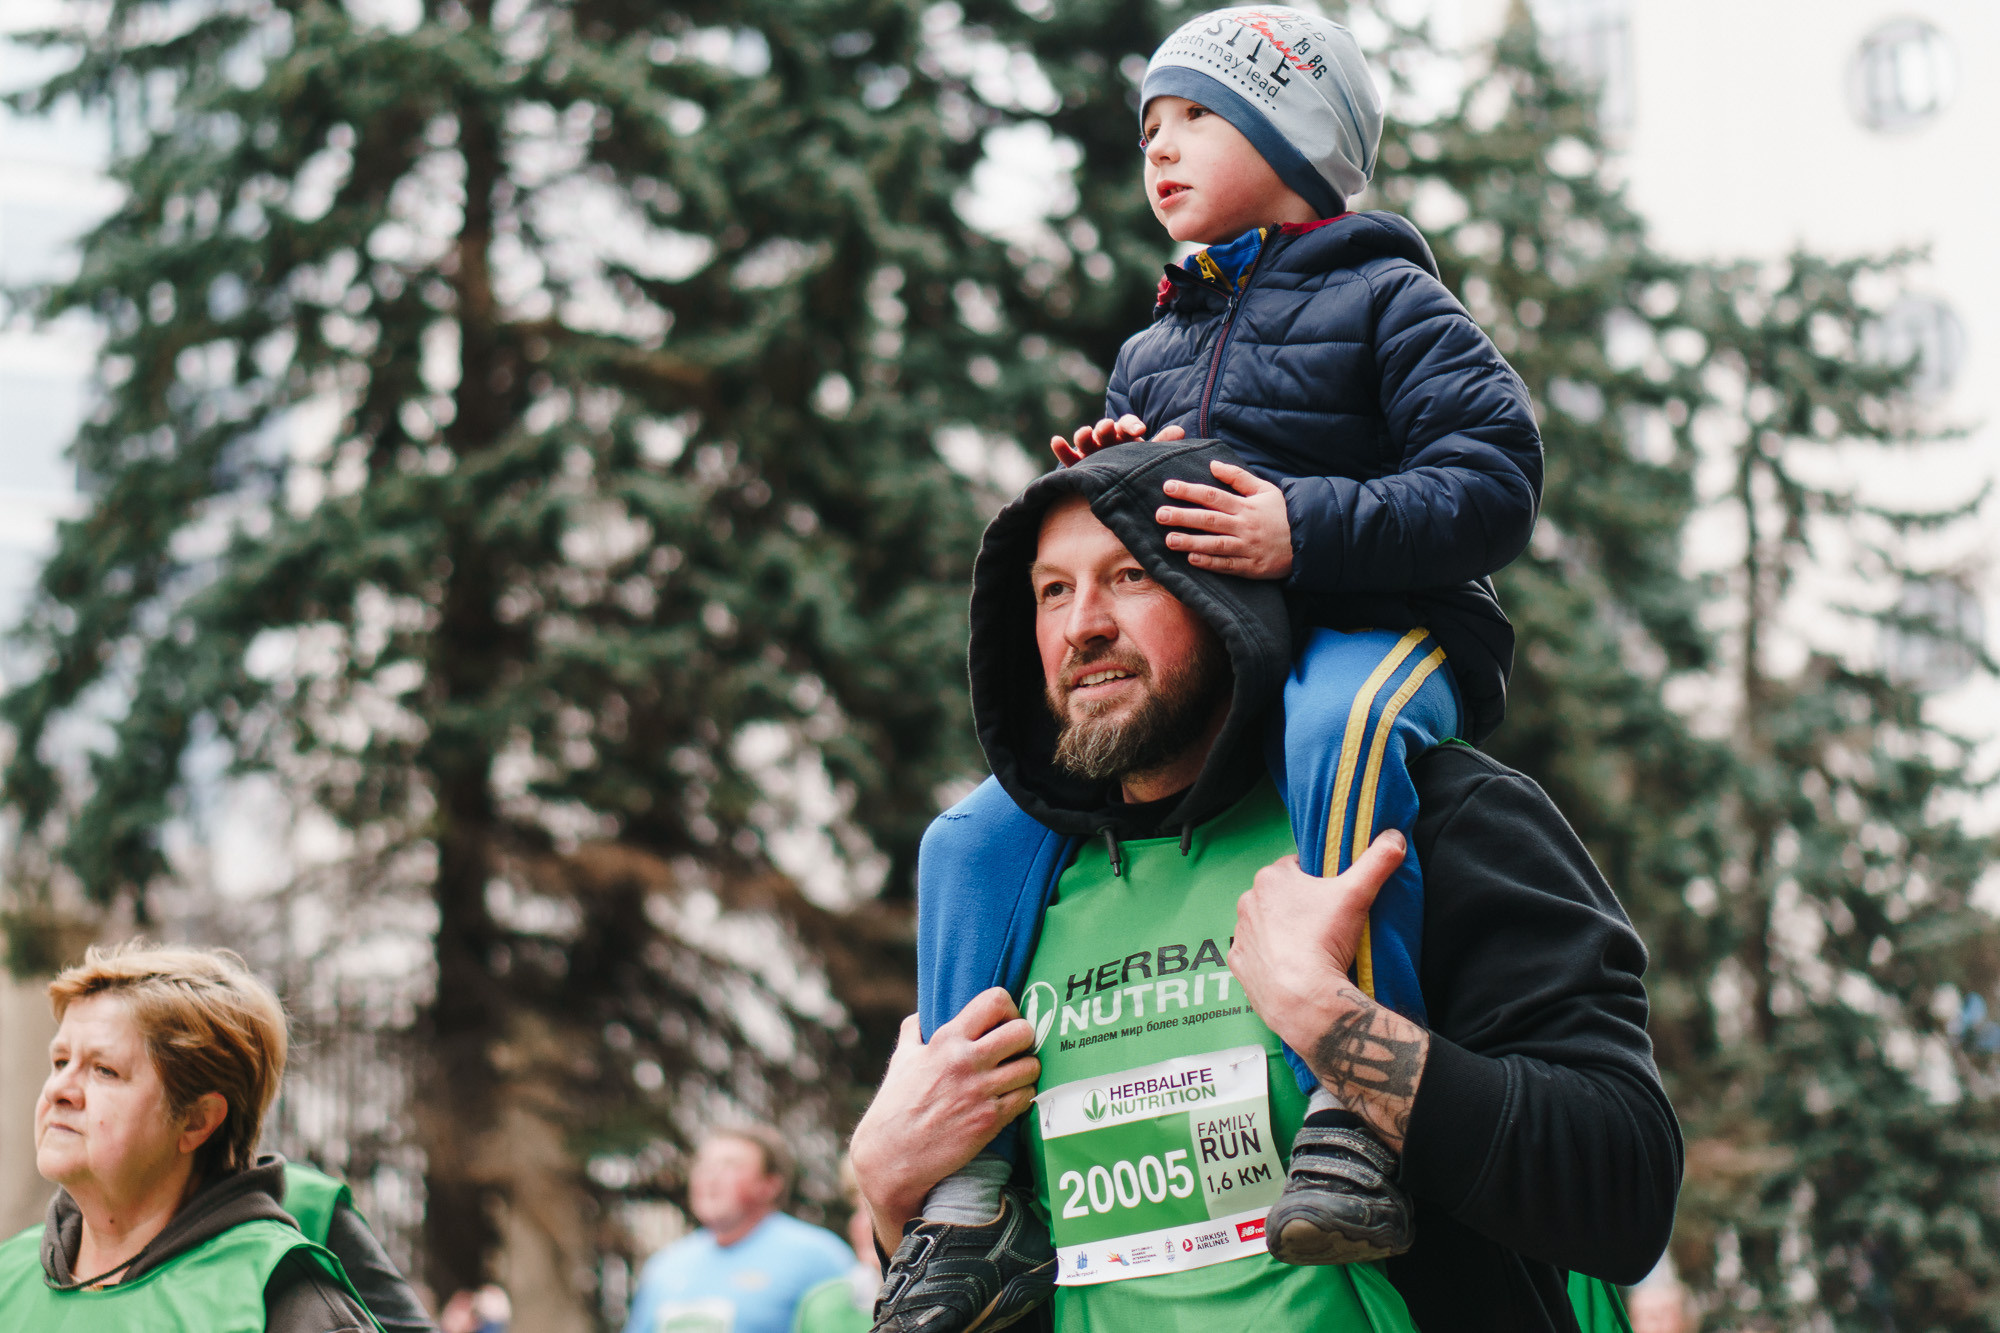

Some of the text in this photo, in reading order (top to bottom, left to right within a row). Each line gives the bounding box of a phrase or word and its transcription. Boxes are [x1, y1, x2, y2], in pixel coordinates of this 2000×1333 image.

[1208, 42, 1244, 69] may
[1246, 64, 1281, 98] lead
[1065, 936, 1235, 1002] HERBA
[1060, 1039, 1076, 1052] Мы
[1078, 1031, 1118, 1049] делаем
[1121, 1025, 1143, 1040] мир
[1146, 1017, 1179, 1033] более
[1182, 1005, 1242, 1026] здоровым
[1109, 1068, 1214, 1101] HERBALIFE
[1111, 1083, 1217, 1117] NUTRITION
[1197, 1112, 1256, 1138] FAMILY
[1200, 1128, 1262, 1164] RUN
[1059, 1148, 1195, 1220] 20005
[1207, 1163, 1272, 1195] 1,6 KM
[1195, 1230, 1227, 1243] TURKISH
[1197, 1237, 1230, 1250] AIRLINES
